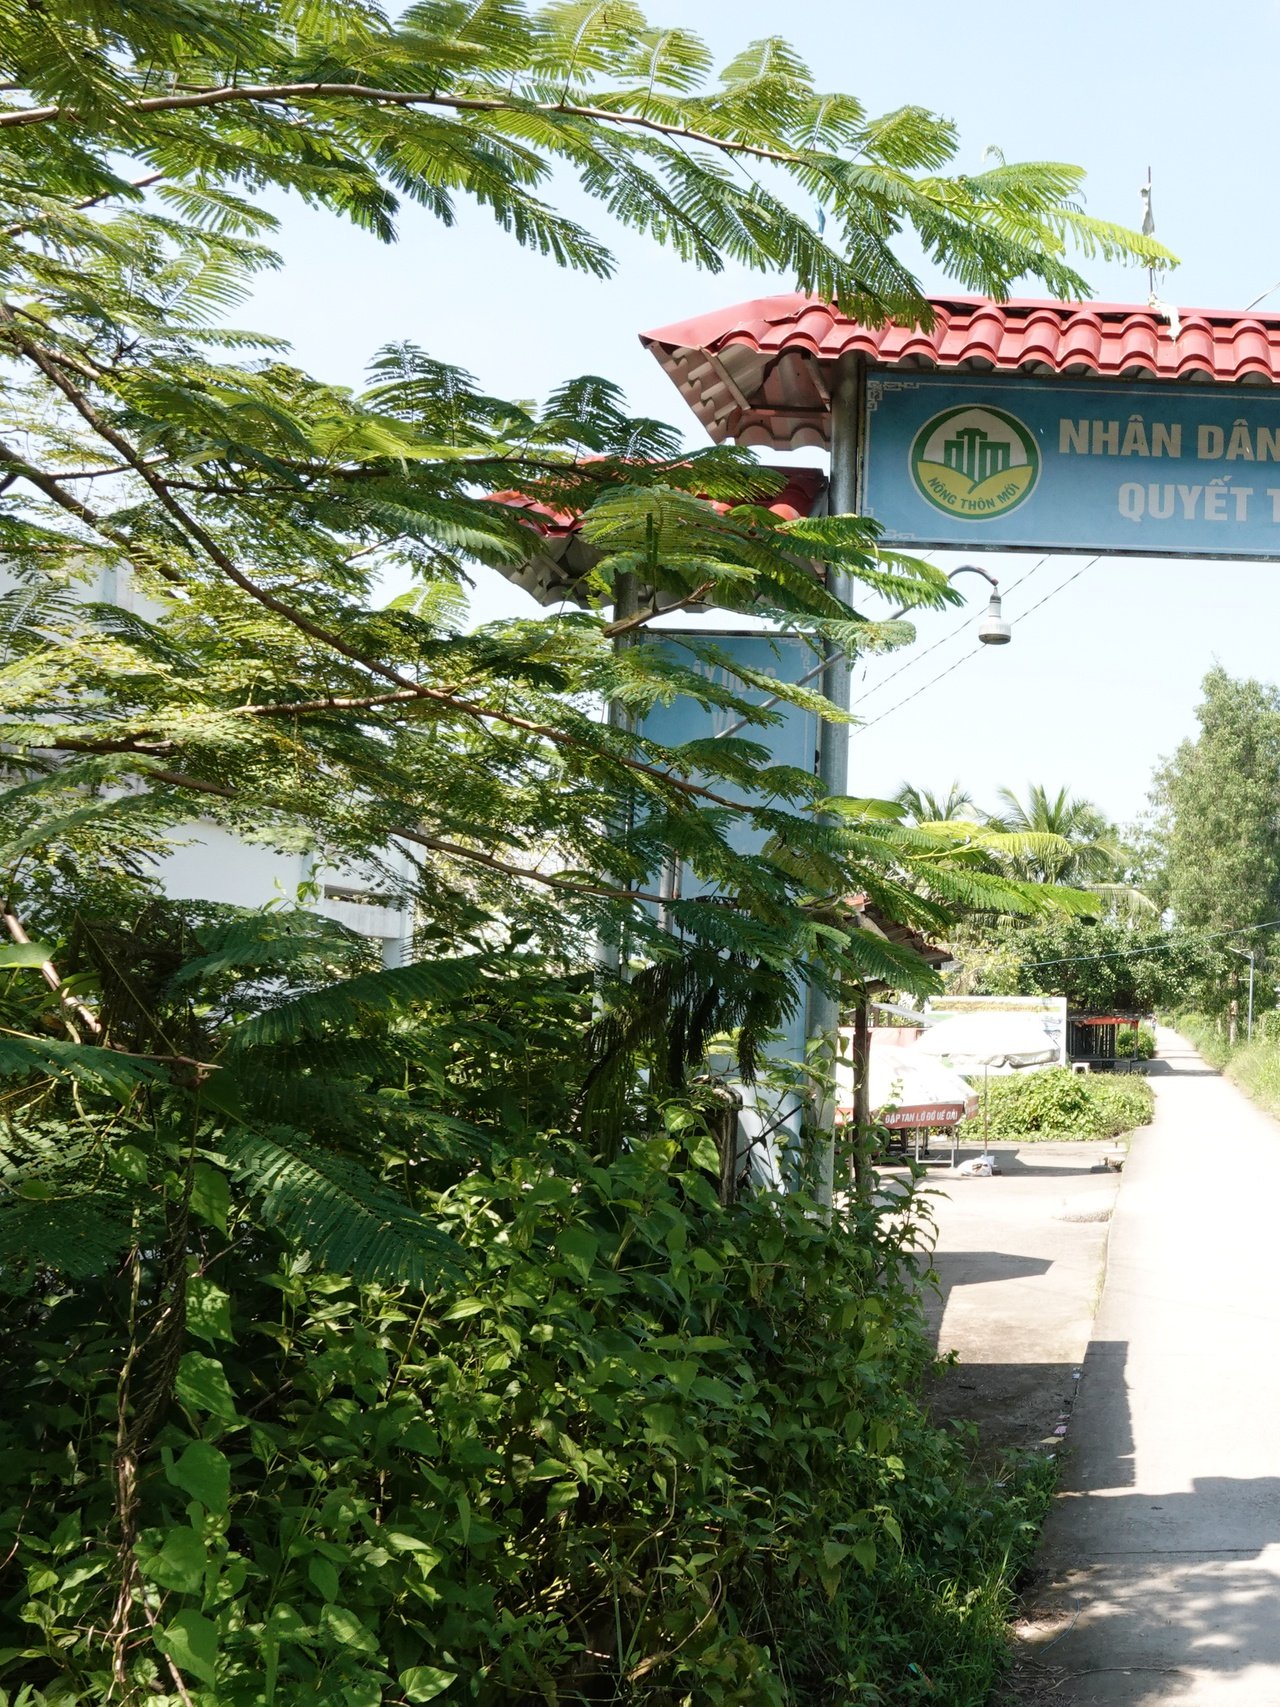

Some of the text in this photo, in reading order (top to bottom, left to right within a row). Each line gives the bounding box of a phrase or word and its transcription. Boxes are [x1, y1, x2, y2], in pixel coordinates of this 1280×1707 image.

[1059, 414, 1181, 458] NHÂN
[928, 477, 1020, 510] NÔNG THÔN MỚI
[1118, 475, 1253, 522] QUYẾT
